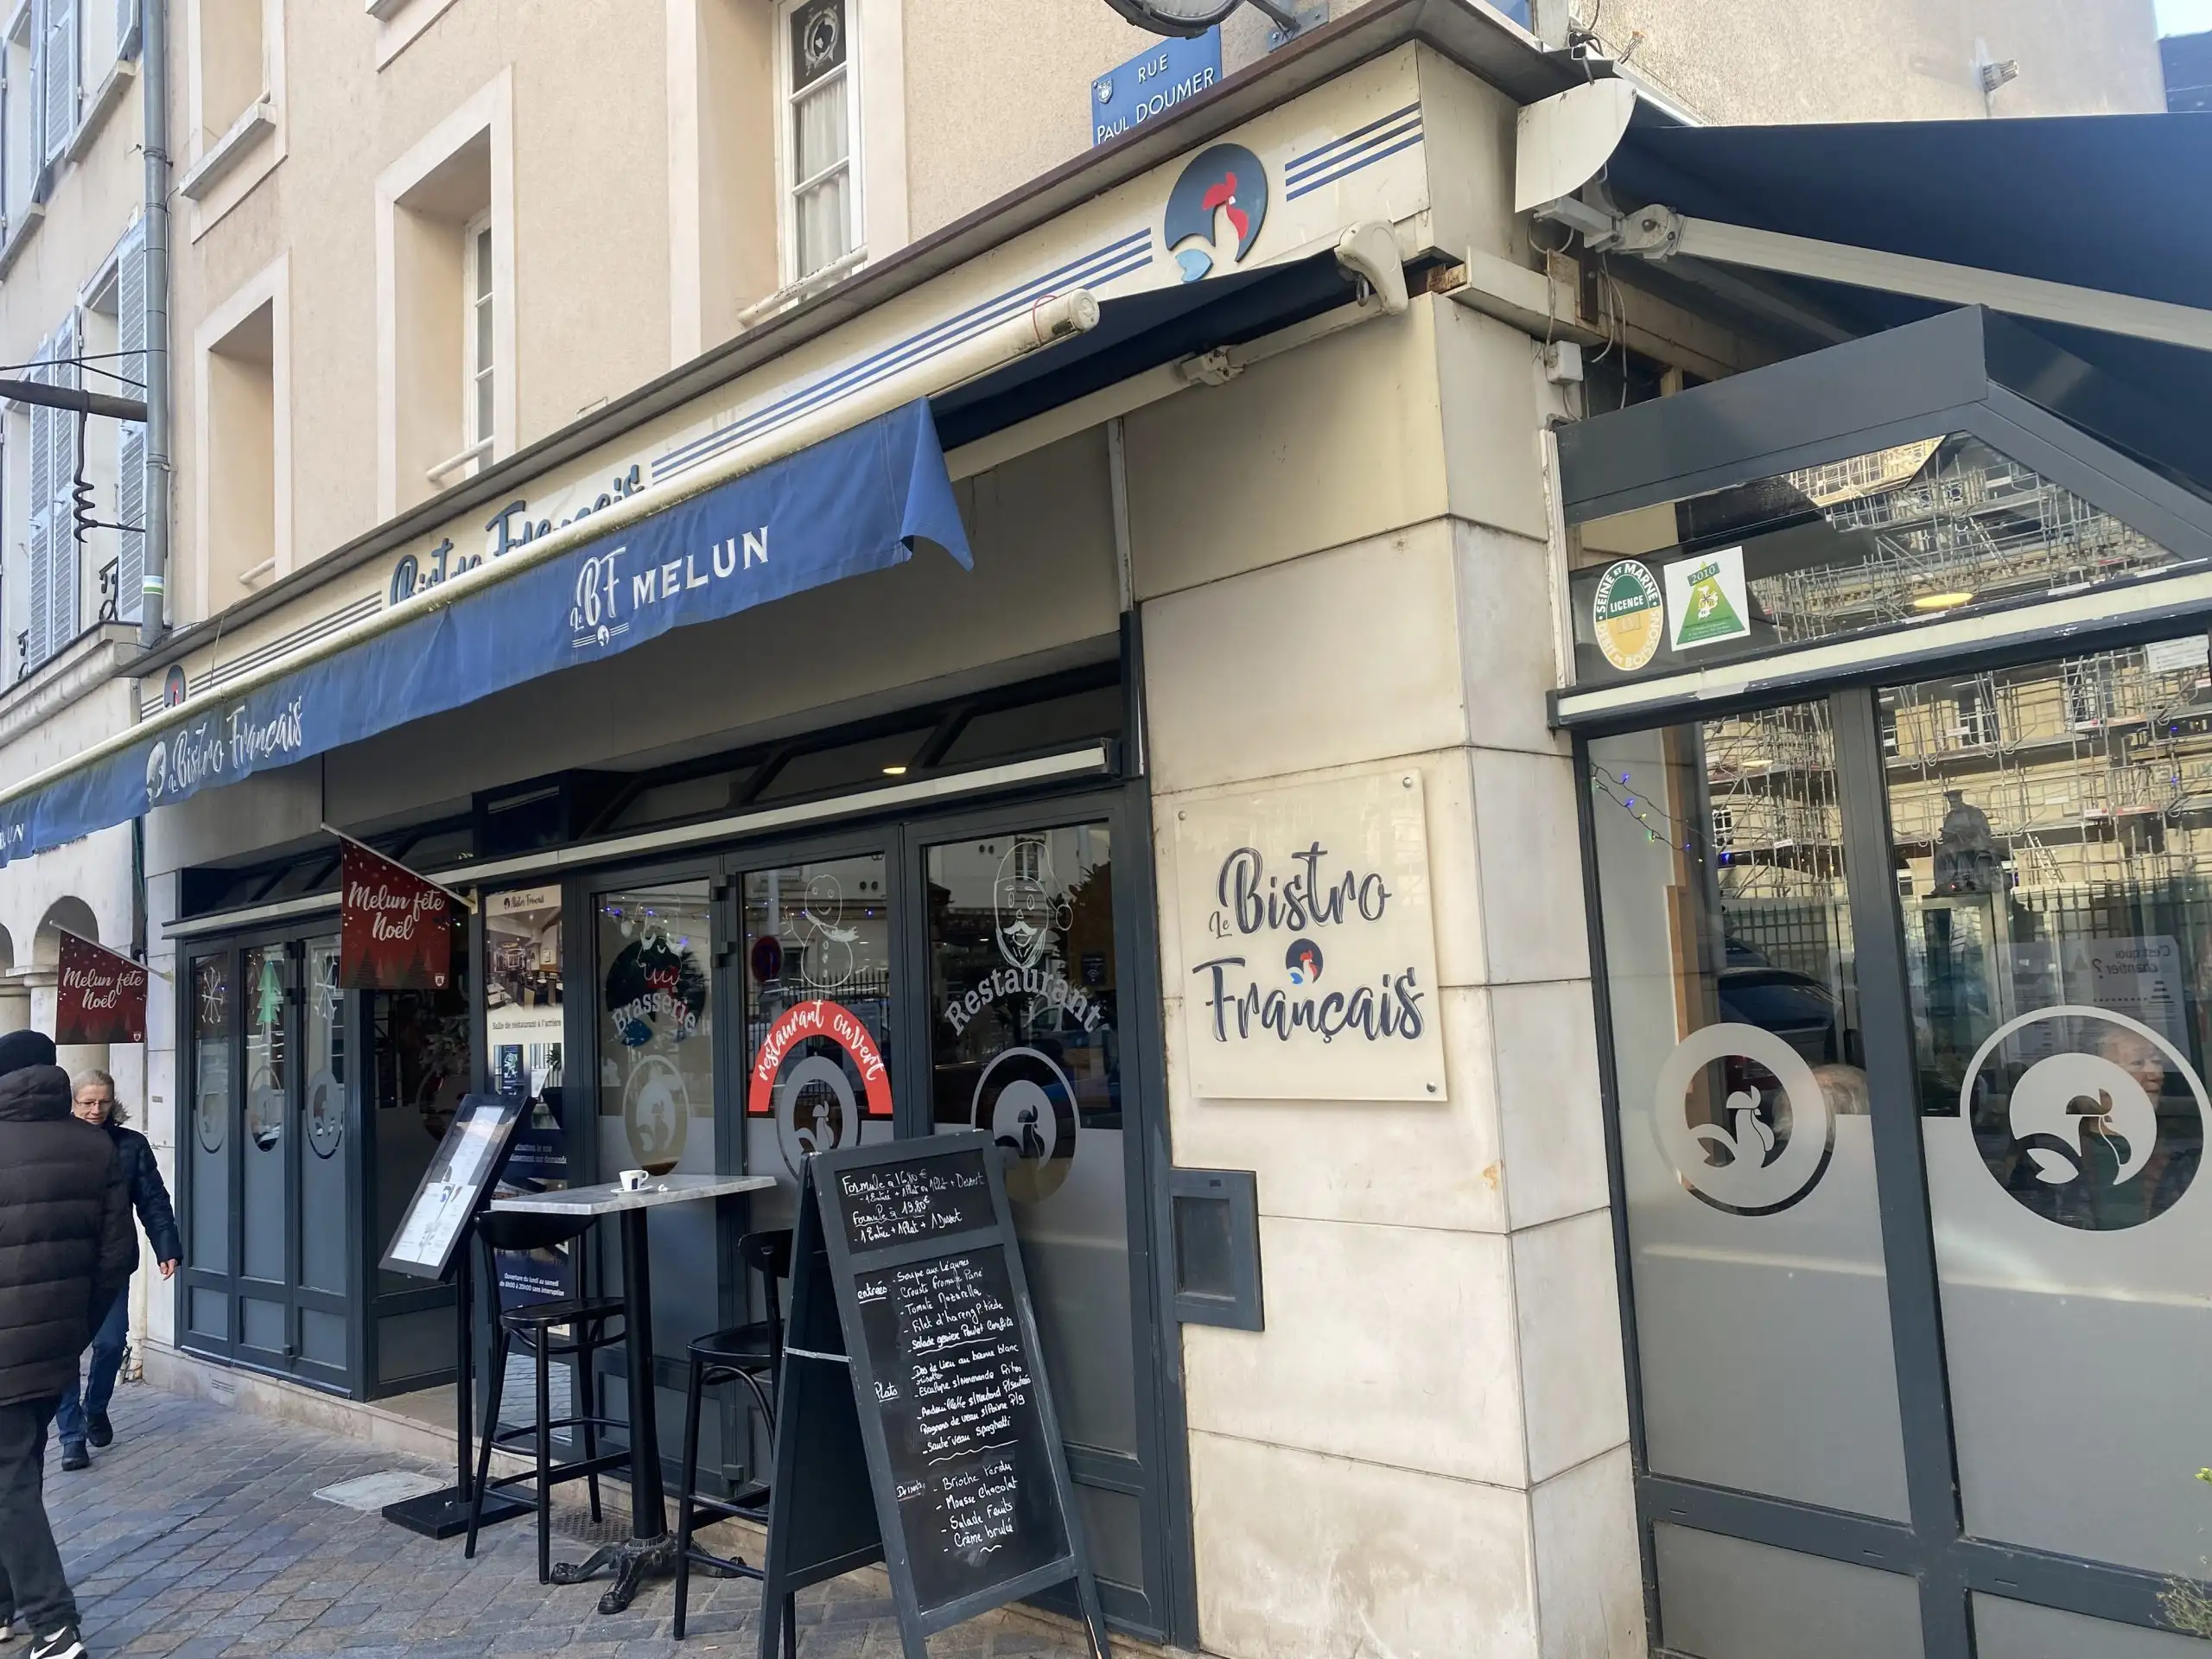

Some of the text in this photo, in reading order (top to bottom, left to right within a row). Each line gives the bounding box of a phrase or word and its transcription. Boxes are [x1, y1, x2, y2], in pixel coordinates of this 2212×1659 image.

[1138, 53, 1168, 84] RUE
[1096, 67, 1215, 145] PAUL DOUMER
[486, 464, 645, 556] Frais
[576, 543, 627, 626] BF
[632, 525, 769, 611] MELUN
[1596, 563, 1659, 613] SEINE ET MARNE
[1691, 565, 1716, 584] 2010
[1610, 594, 1644, 613] LICENCE
[1625, 607, 1661, 668] BOISSONS
[173, 721, 225, 788] Bistro
[226, 695, 303, 769] Français
[347, 880, 445, 922] Melun fête
[1208, 841, 1392, 939] Le Bistro
[372, 912, 415, 941] Noël
[62, 967, 145, 995] Melun fête
[82, 988, 118, 1010] Noël
[944, 967, 1102, 1037] Restaurant
[1192, 956, 1425, 1044] Français
[505, 1020, 512, 1029] de
[611, 991, 696, 1037] Brasserie
[758, 999, 885, 1081] restaurant ouvert
[842, 1173, 886, 1195] Formule
[852, 1204, 887, 1225] Formule
[896, 1269, 925, 1286] Soupe
[925, 1266, 939, 1276] aux
[905, 1296, 933, 1315] Tomate
[957, 1356, 970, 1365] au
[997, 1343, 1020, 1355] blanc
[874, 1381, 898, 1400] Plats
[961, 1413, 979, 1423] veau
[942, 1471, 980, 1491] Brioche
[978, 1475, 1018, 1498] Chocolat
[950, 1510, 983, 1530] Salade
